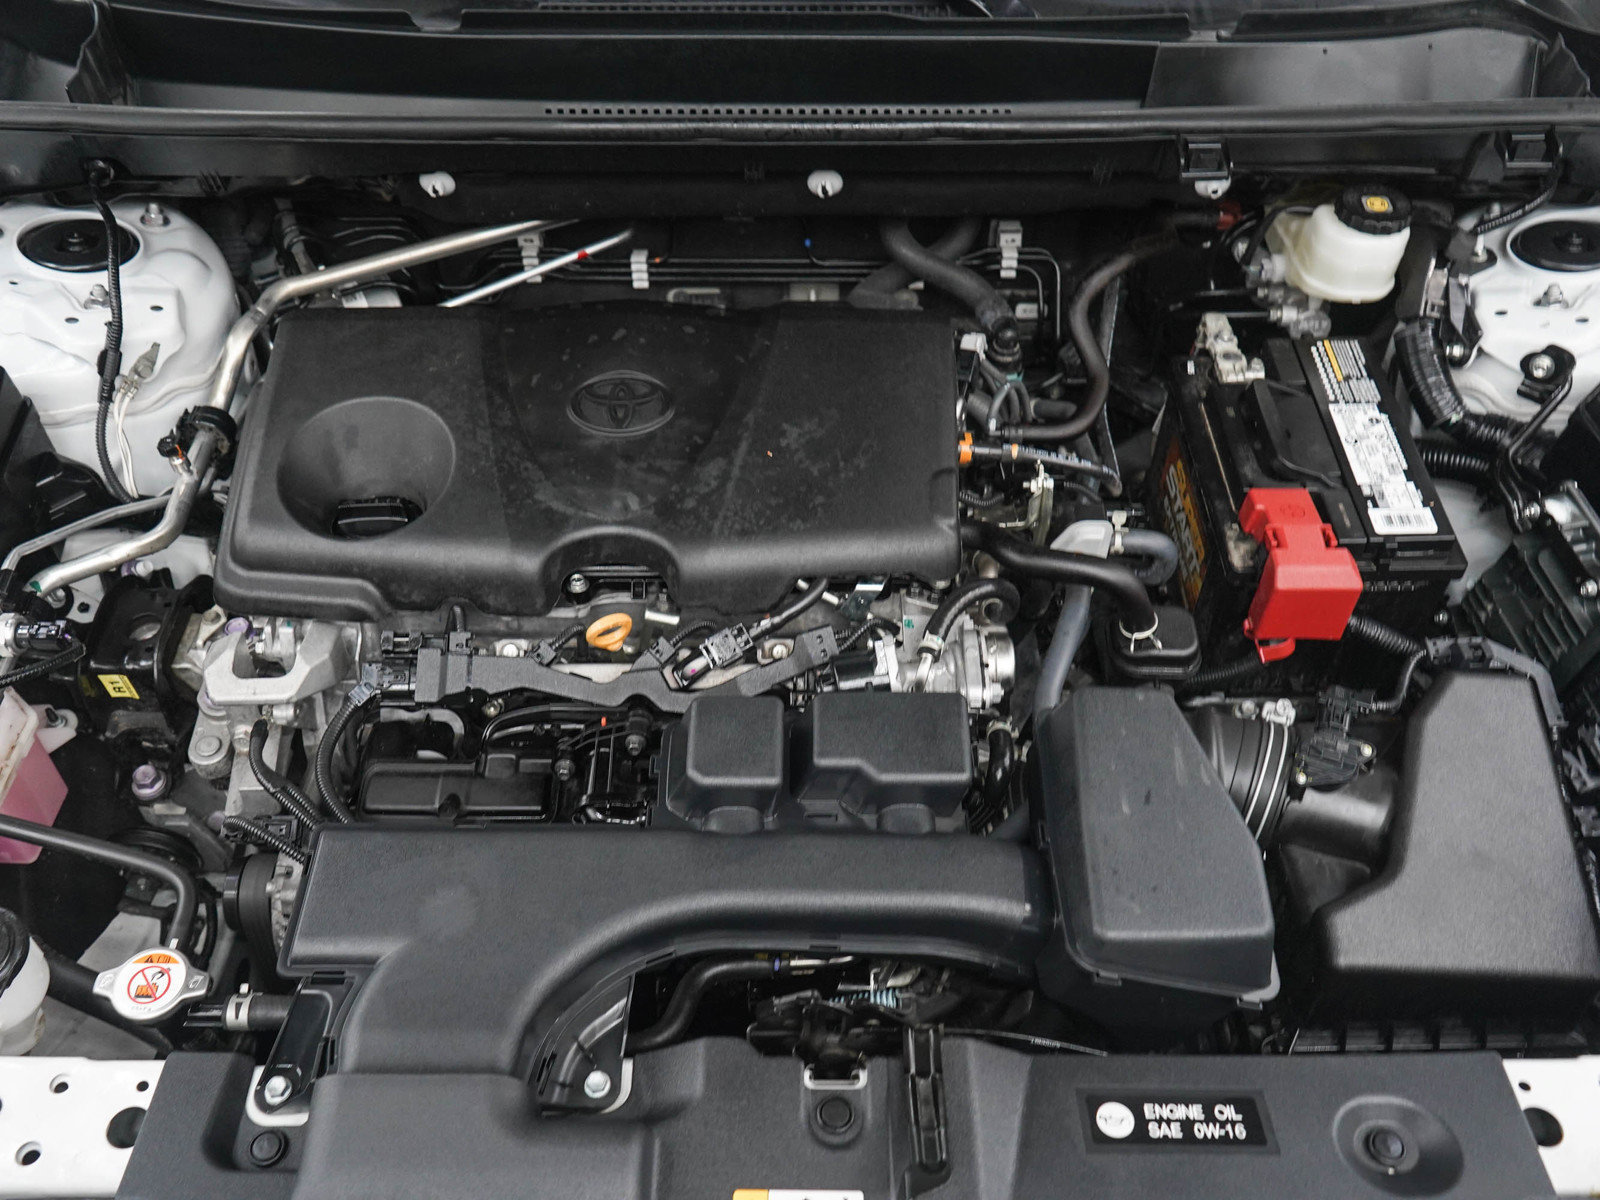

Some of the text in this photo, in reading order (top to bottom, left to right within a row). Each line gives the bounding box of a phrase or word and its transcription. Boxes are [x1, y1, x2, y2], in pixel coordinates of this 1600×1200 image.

[1166, 464, 1200, 577] START
[1143, 1102, 1243, 1121] ENGINE OIL
[1148, 1121, 1247, 1140] SAE 0W-16
